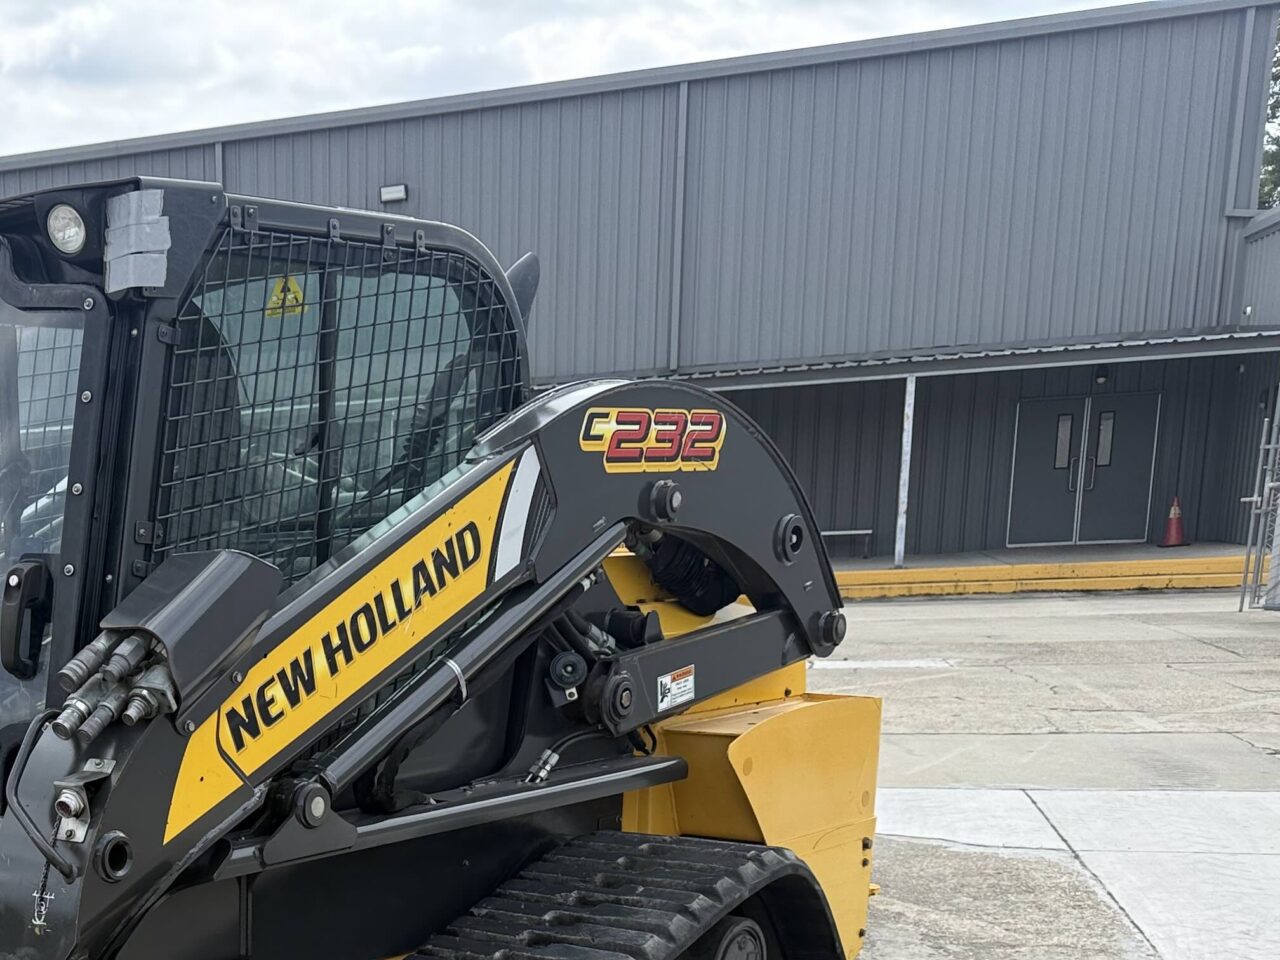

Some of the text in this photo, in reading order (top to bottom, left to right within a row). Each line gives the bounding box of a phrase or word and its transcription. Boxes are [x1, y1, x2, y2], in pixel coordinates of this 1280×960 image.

[580, 408, 726, 470] C232
[224, 520, 482, 754] NEW HOLLAND
